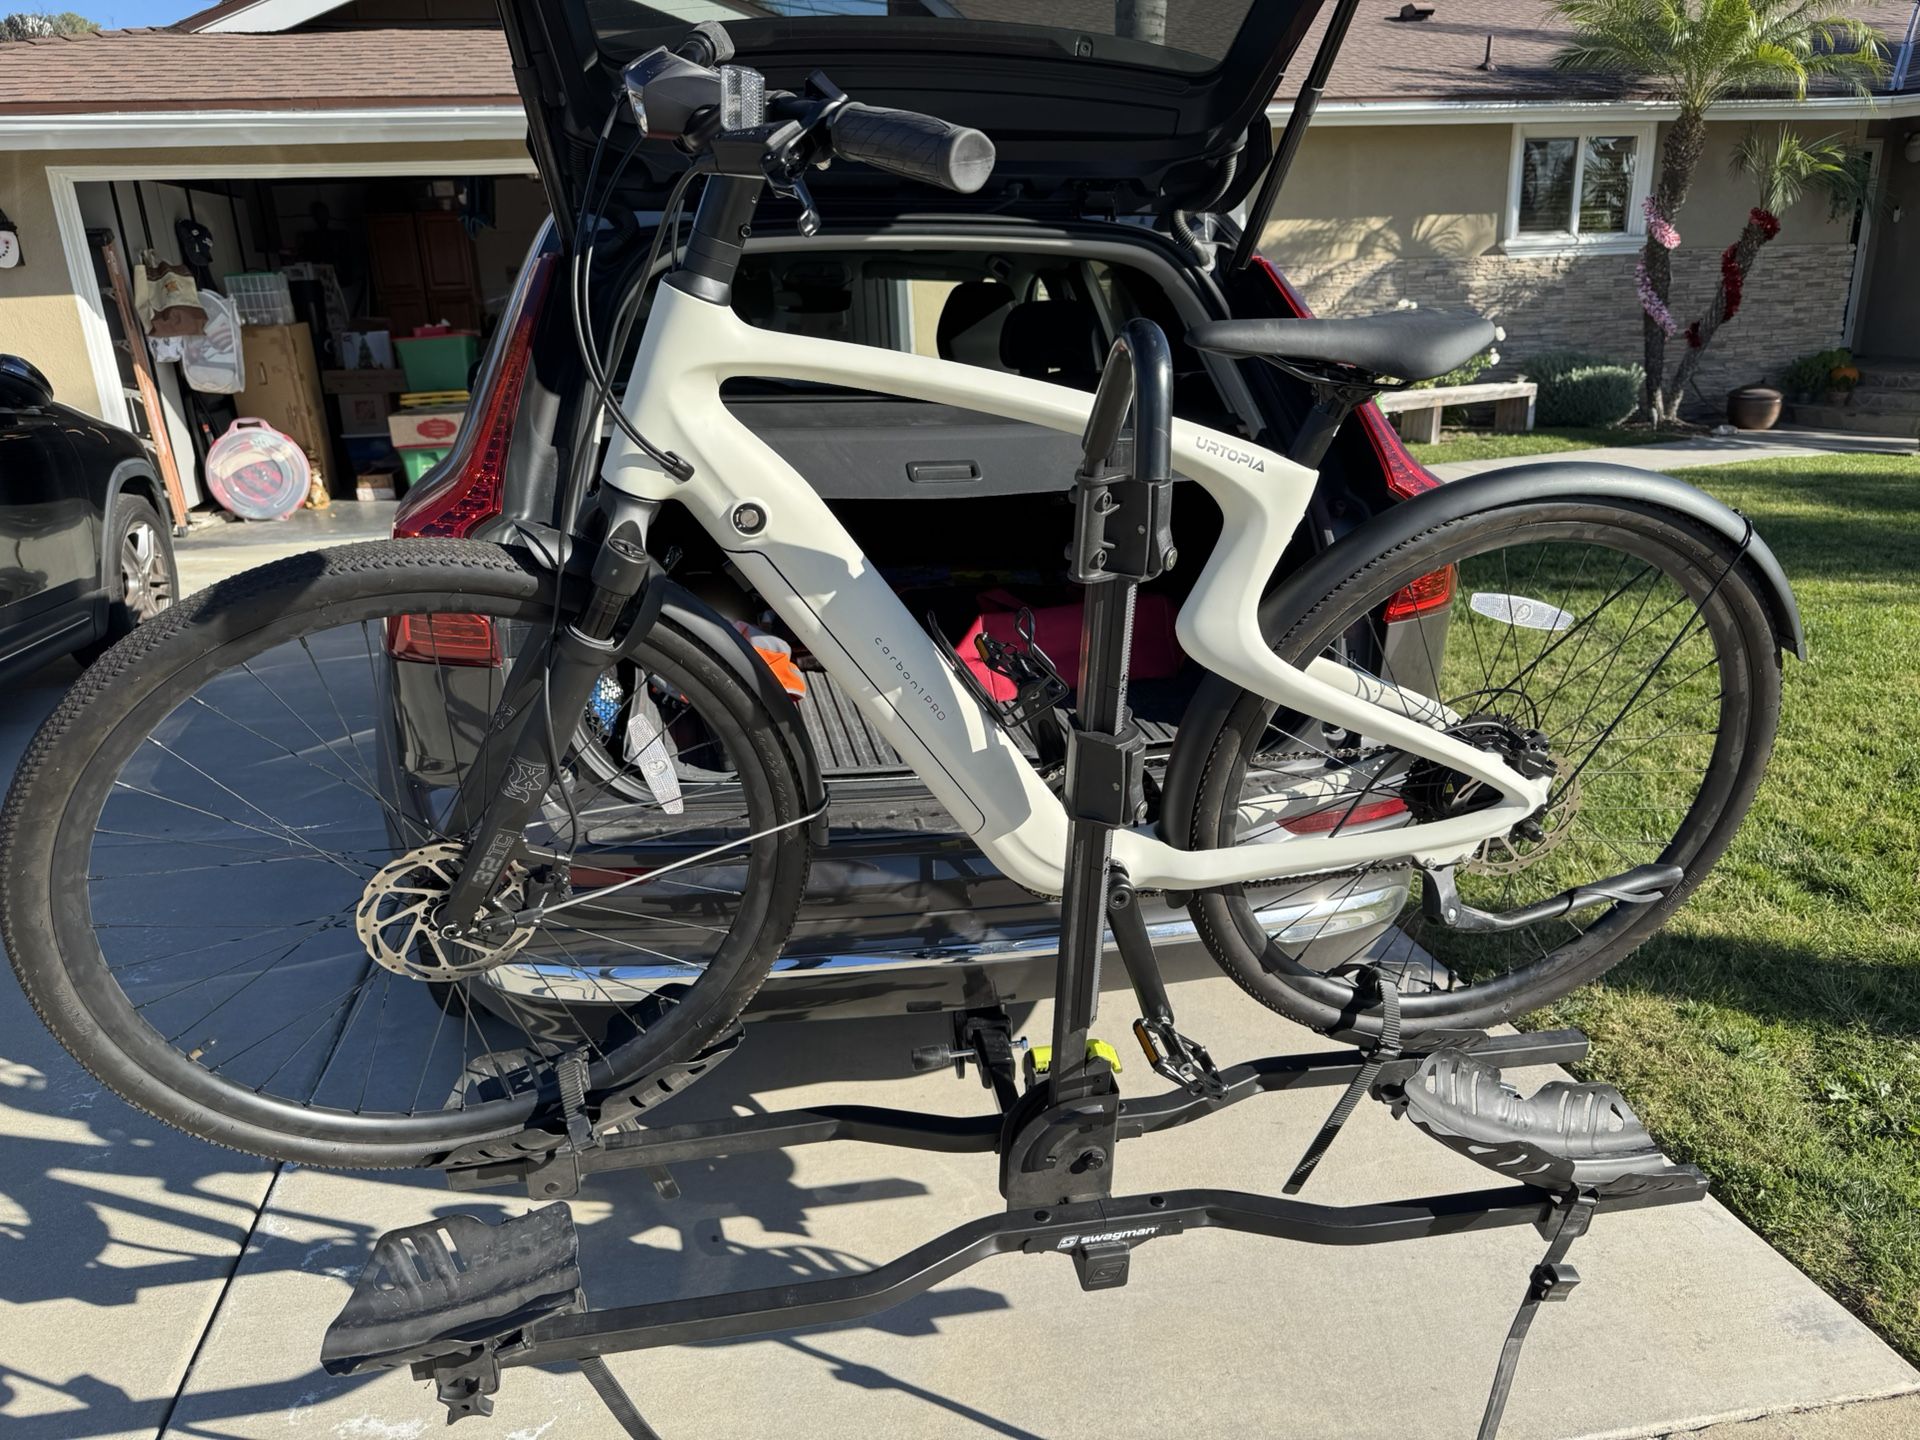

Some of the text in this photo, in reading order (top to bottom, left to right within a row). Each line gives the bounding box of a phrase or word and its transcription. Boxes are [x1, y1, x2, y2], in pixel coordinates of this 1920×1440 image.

[1196, 436, 1264, 473] URTOPIA
[471, 833, 513, 885] 32TC
[1080, 1226, 1157, 1244] swagman
